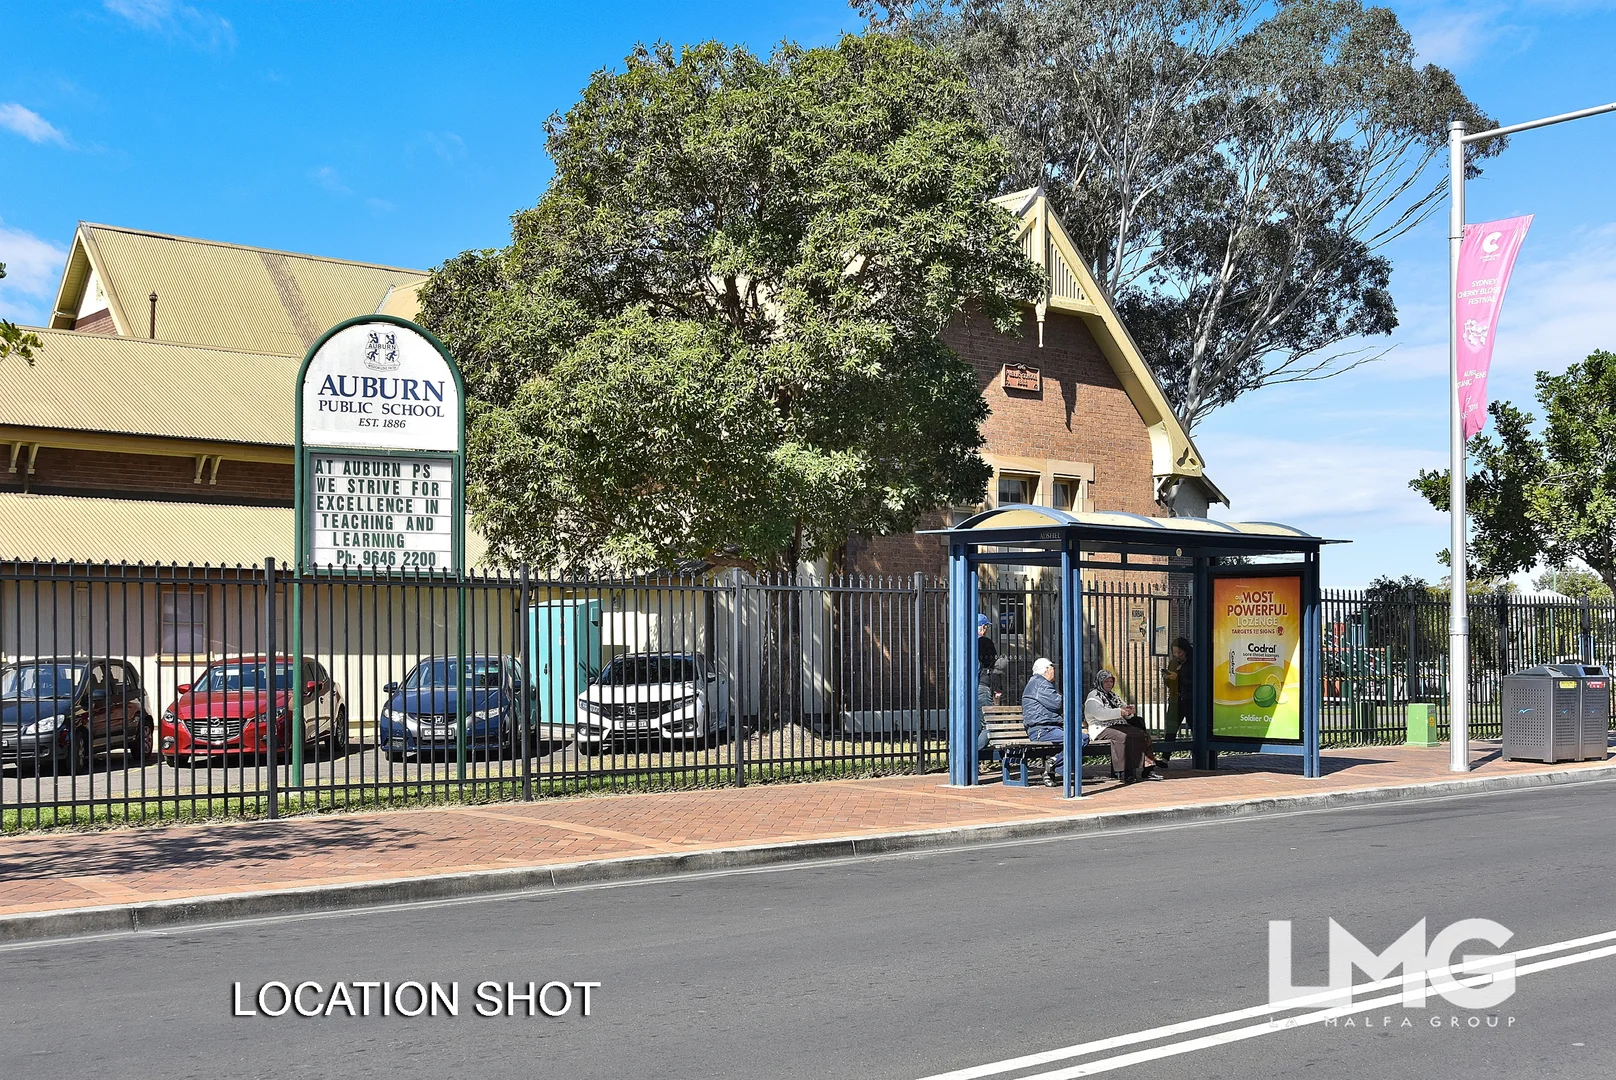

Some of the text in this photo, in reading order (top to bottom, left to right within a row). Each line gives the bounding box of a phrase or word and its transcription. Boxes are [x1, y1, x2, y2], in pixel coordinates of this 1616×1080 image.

[1471, 278, 1498, 288] SYDNEY
[1457, 289, 1479, 299] CHERRY
[1468, 295, 1498, 306] FESTIVAL
[317, 374, 446, 402] AUBURN
[319, 400, 445, 418] PUBLIC SCHOOL
[358, 418, 407, 429] EST. 1886
[315, 459, 431, 479] AT AUBURN PS
[316, 478, 440, 497] WE STRIVE FOR
[317, 495, 439, 514] EXCELLENCE IN
[322, 513, 434, 532] TEACHING AND
[333, 531, 405, 549] LEARNING
[336, 550, 436, 567] Ph: 9646 2200
[1241, 591, 1274, 603] MOST
[1227, 603, 1288, 617] POWERFUL
[1237, 617, 1278, 627] LOZENGE
[1247, 642, 1277, 653] Codral
[1240, 714, 1262, 722] Soldier
